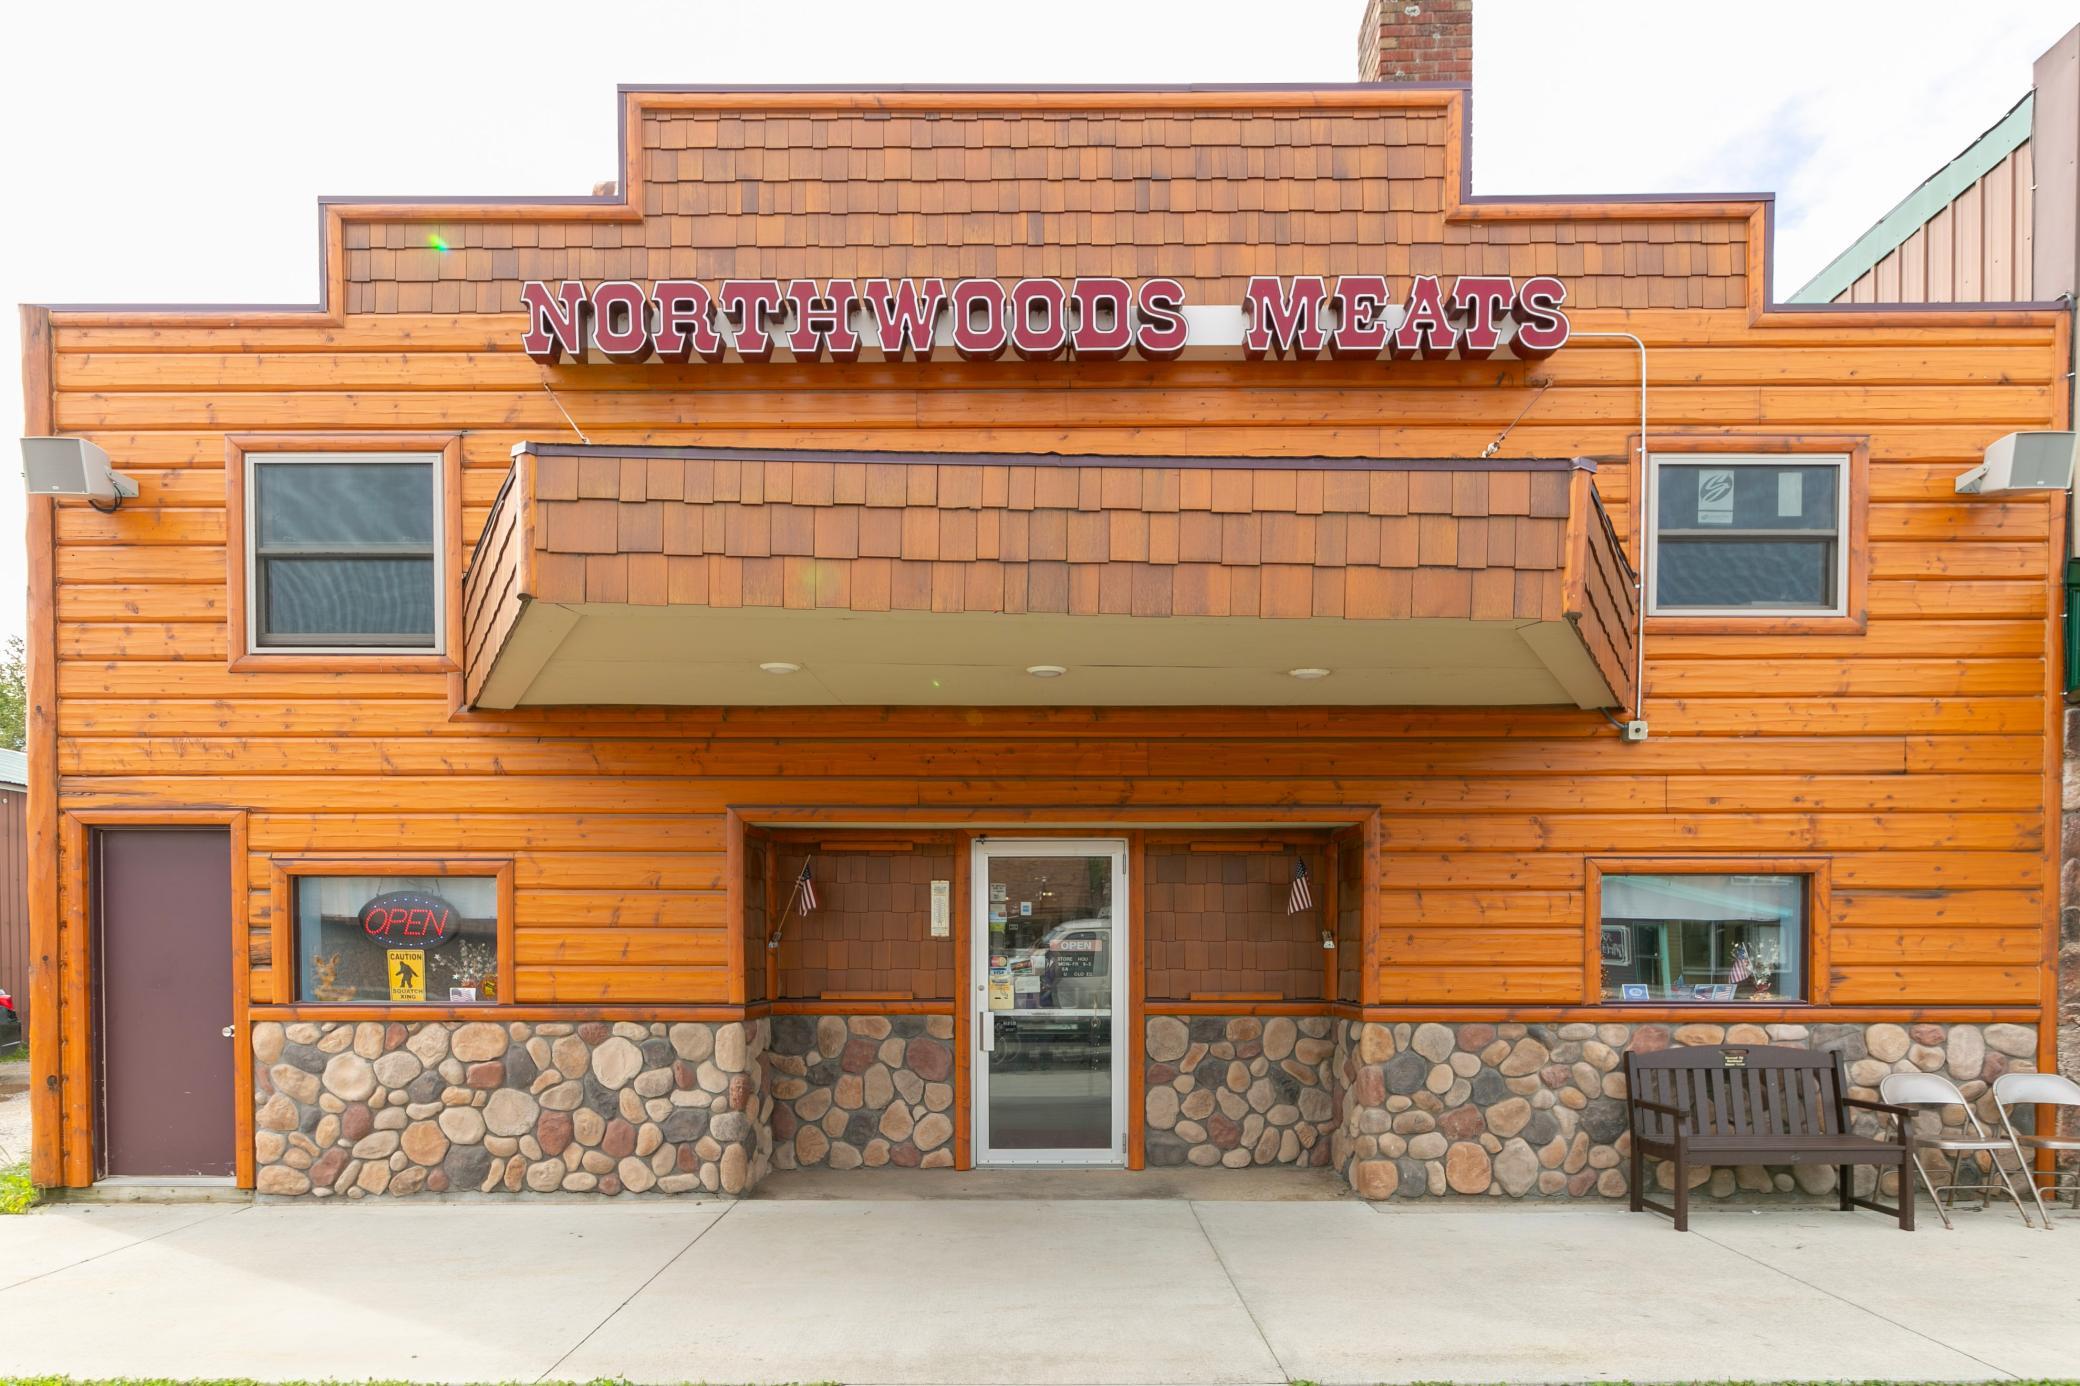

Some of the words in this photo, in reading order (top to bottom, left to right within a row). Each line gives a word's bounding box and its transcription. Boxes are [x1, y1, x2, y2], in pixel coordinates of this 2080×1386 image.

[520, 277, 1190, 355] NORTHWOODS
[1245, 275, 1571, 351] MEATS
[364, 907, 449, 936] OPEN
[1060, 941, 1092, 950] OPEN
[390, 953, 422, 961] CAUTION
